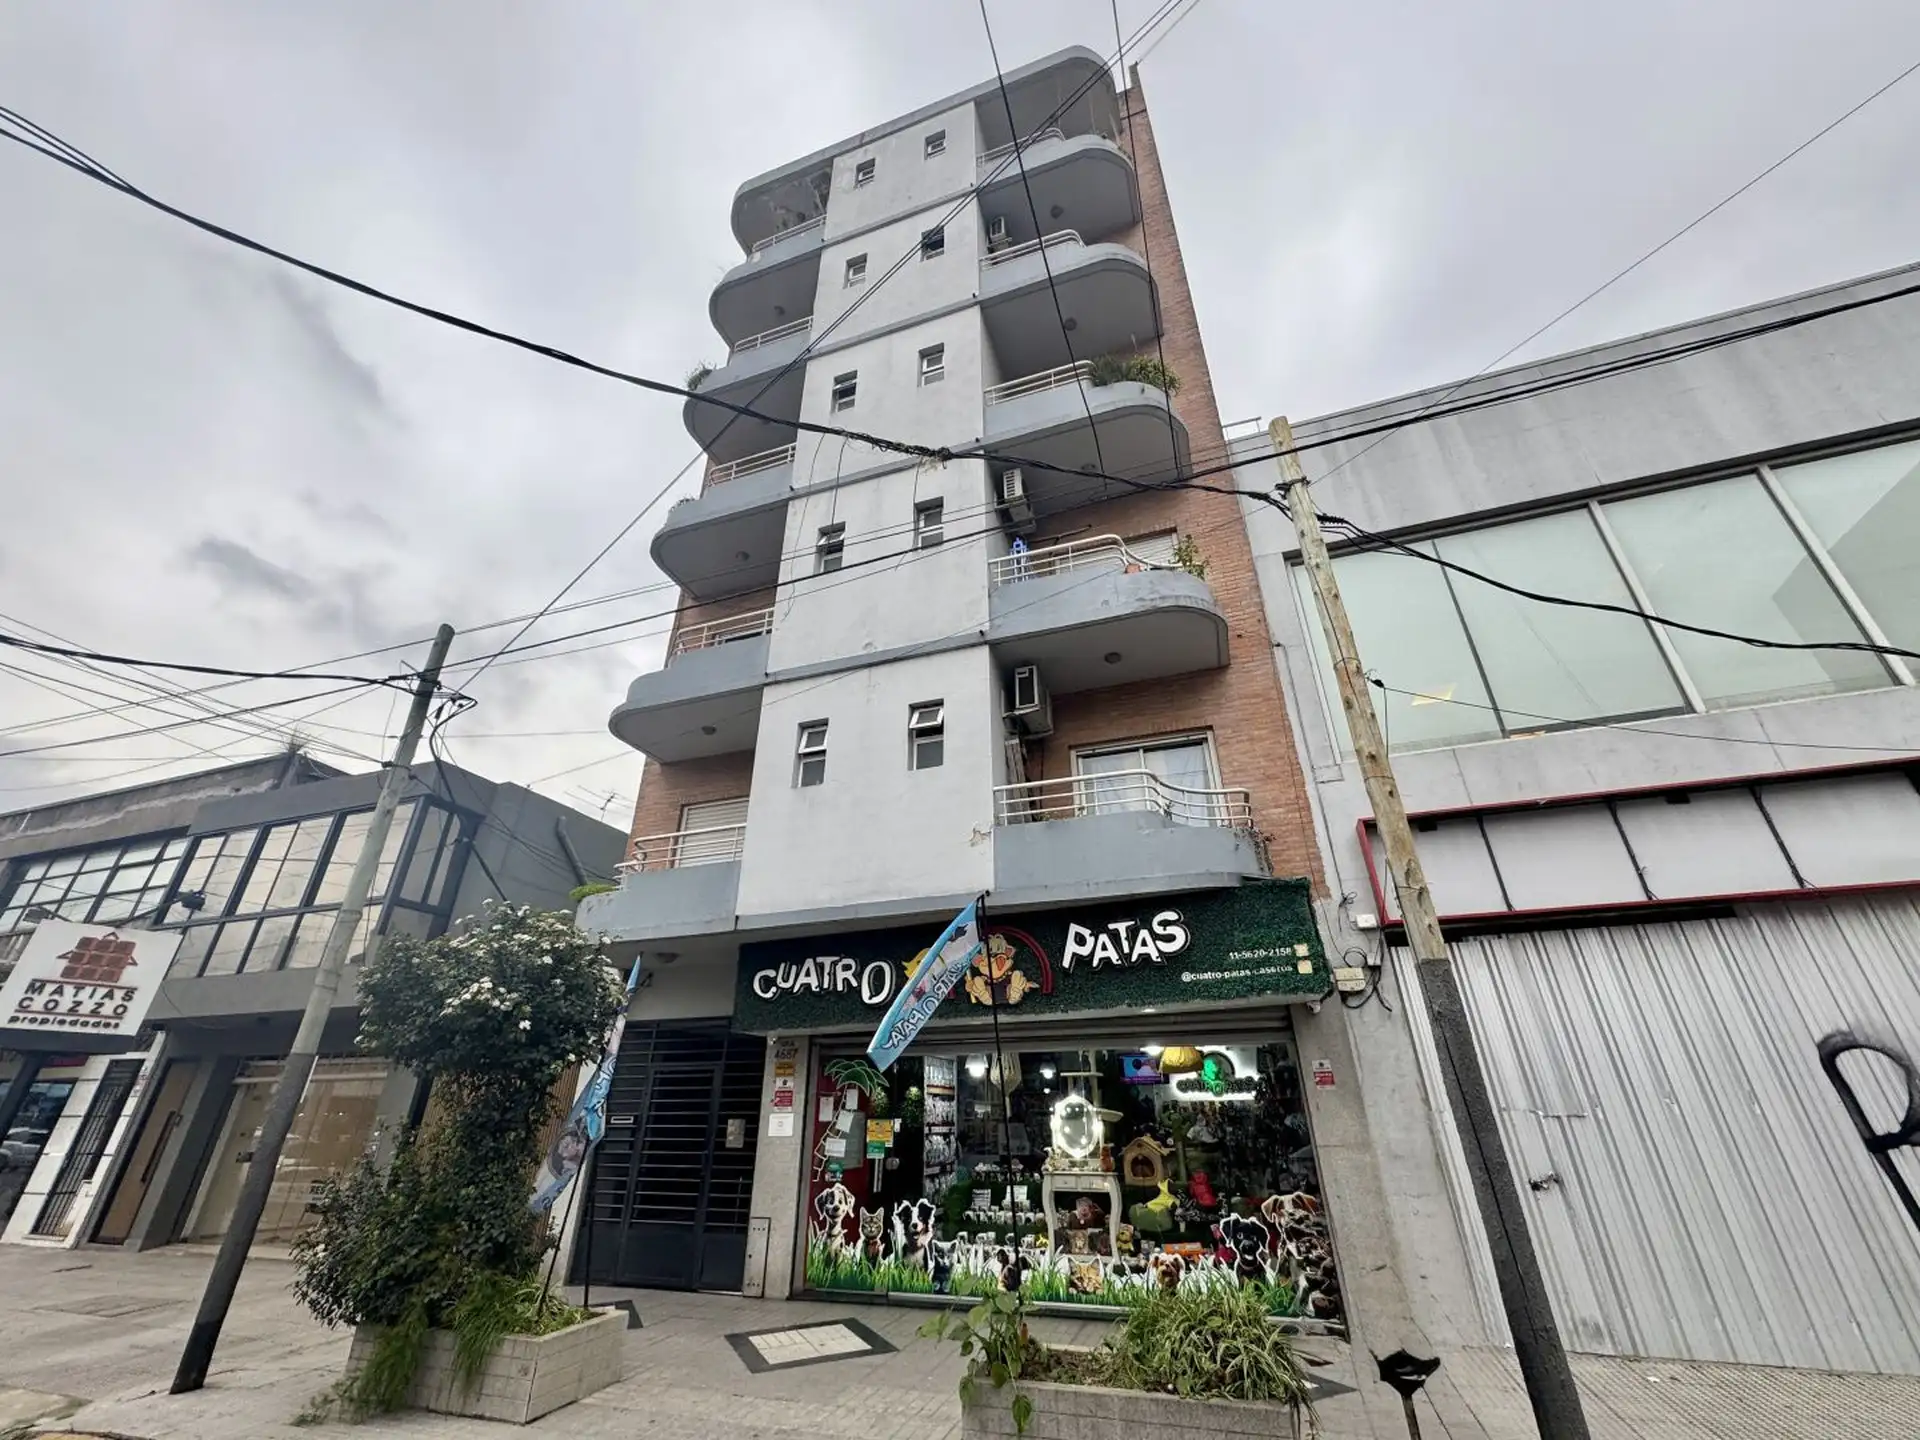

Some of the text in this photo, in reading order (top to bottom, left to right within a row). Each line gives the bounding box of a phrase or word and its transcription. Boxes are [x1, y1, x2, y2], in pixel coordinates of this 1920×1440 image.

[753, 909, 1190, 1005] CUATRO PATAS
[24, 981, 136, 1003] MATIAS
[17, 996, 129, 1017] COZZO
[7, 1015, 120, 1029] propiedades
